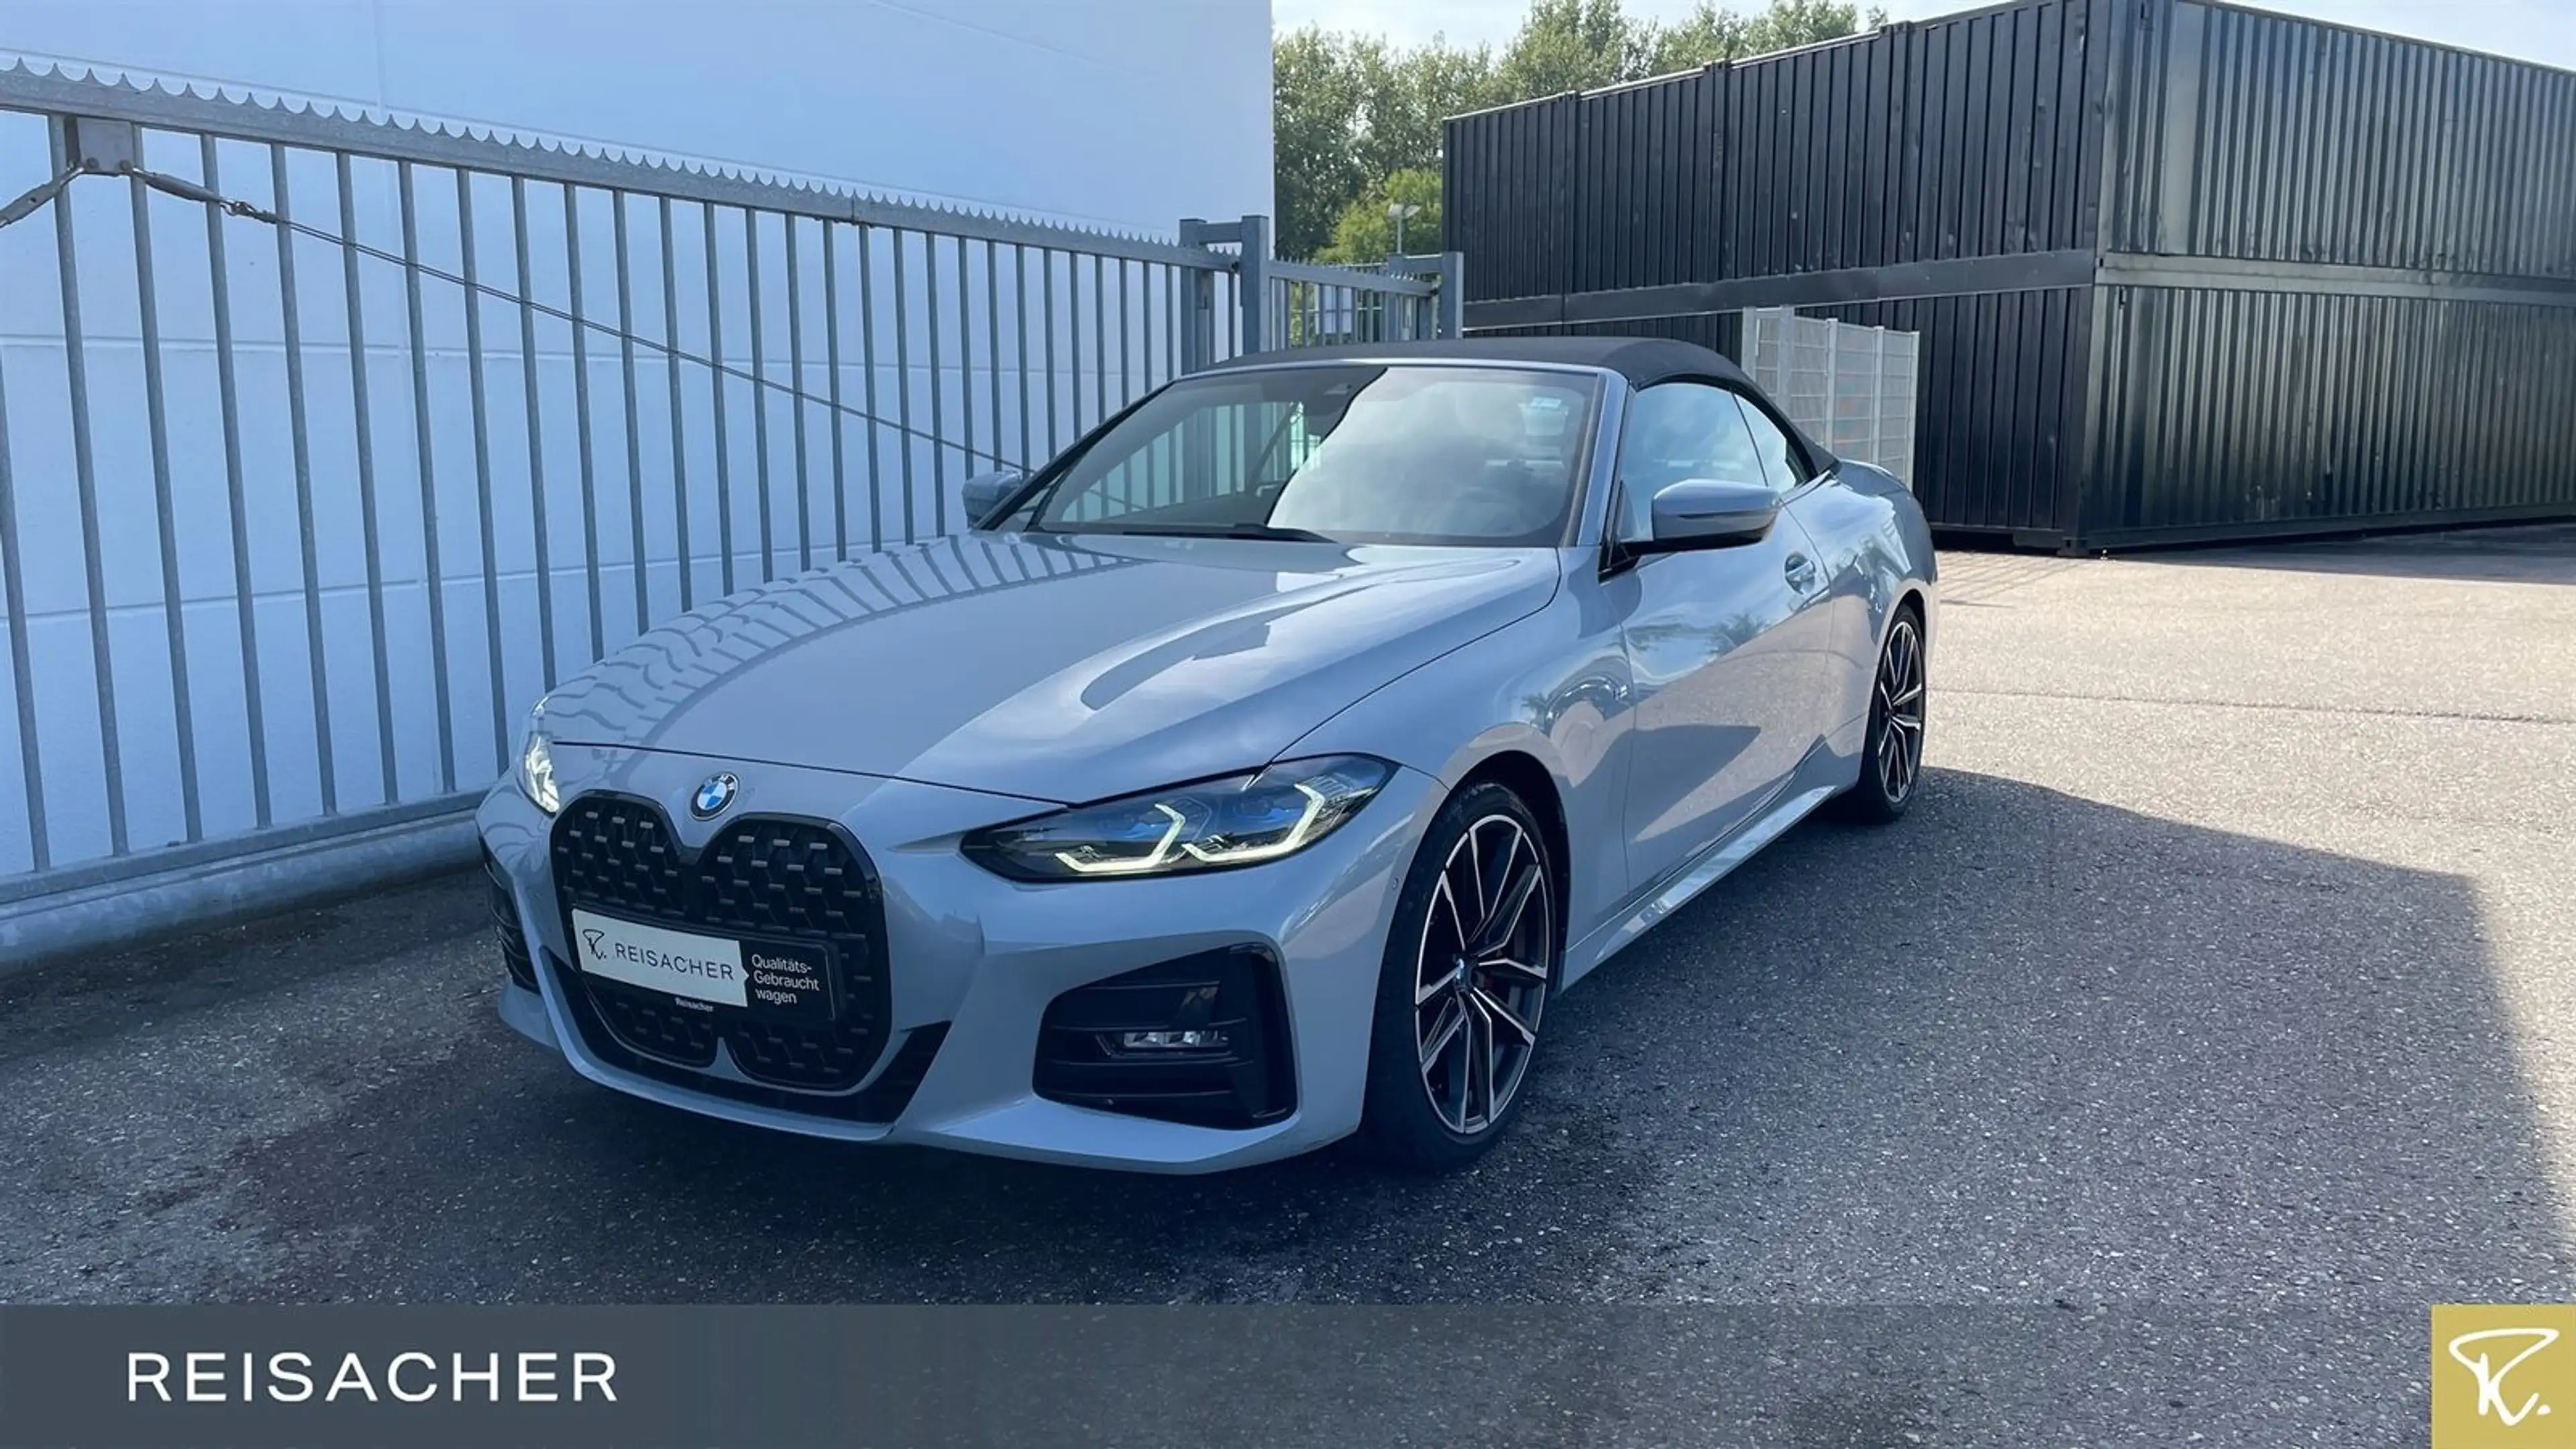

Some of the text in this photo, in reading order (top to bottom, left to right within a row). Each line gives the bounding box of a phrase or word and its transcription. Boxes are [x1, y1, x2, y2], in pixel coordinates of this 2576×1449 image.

[615, 943, 734, 980] REISACHER
[751, 953, 812, 973] Qualitäts-
[753, 970, 820, 991] Gebraucht
[755, 988, 797, 1005] wagen
